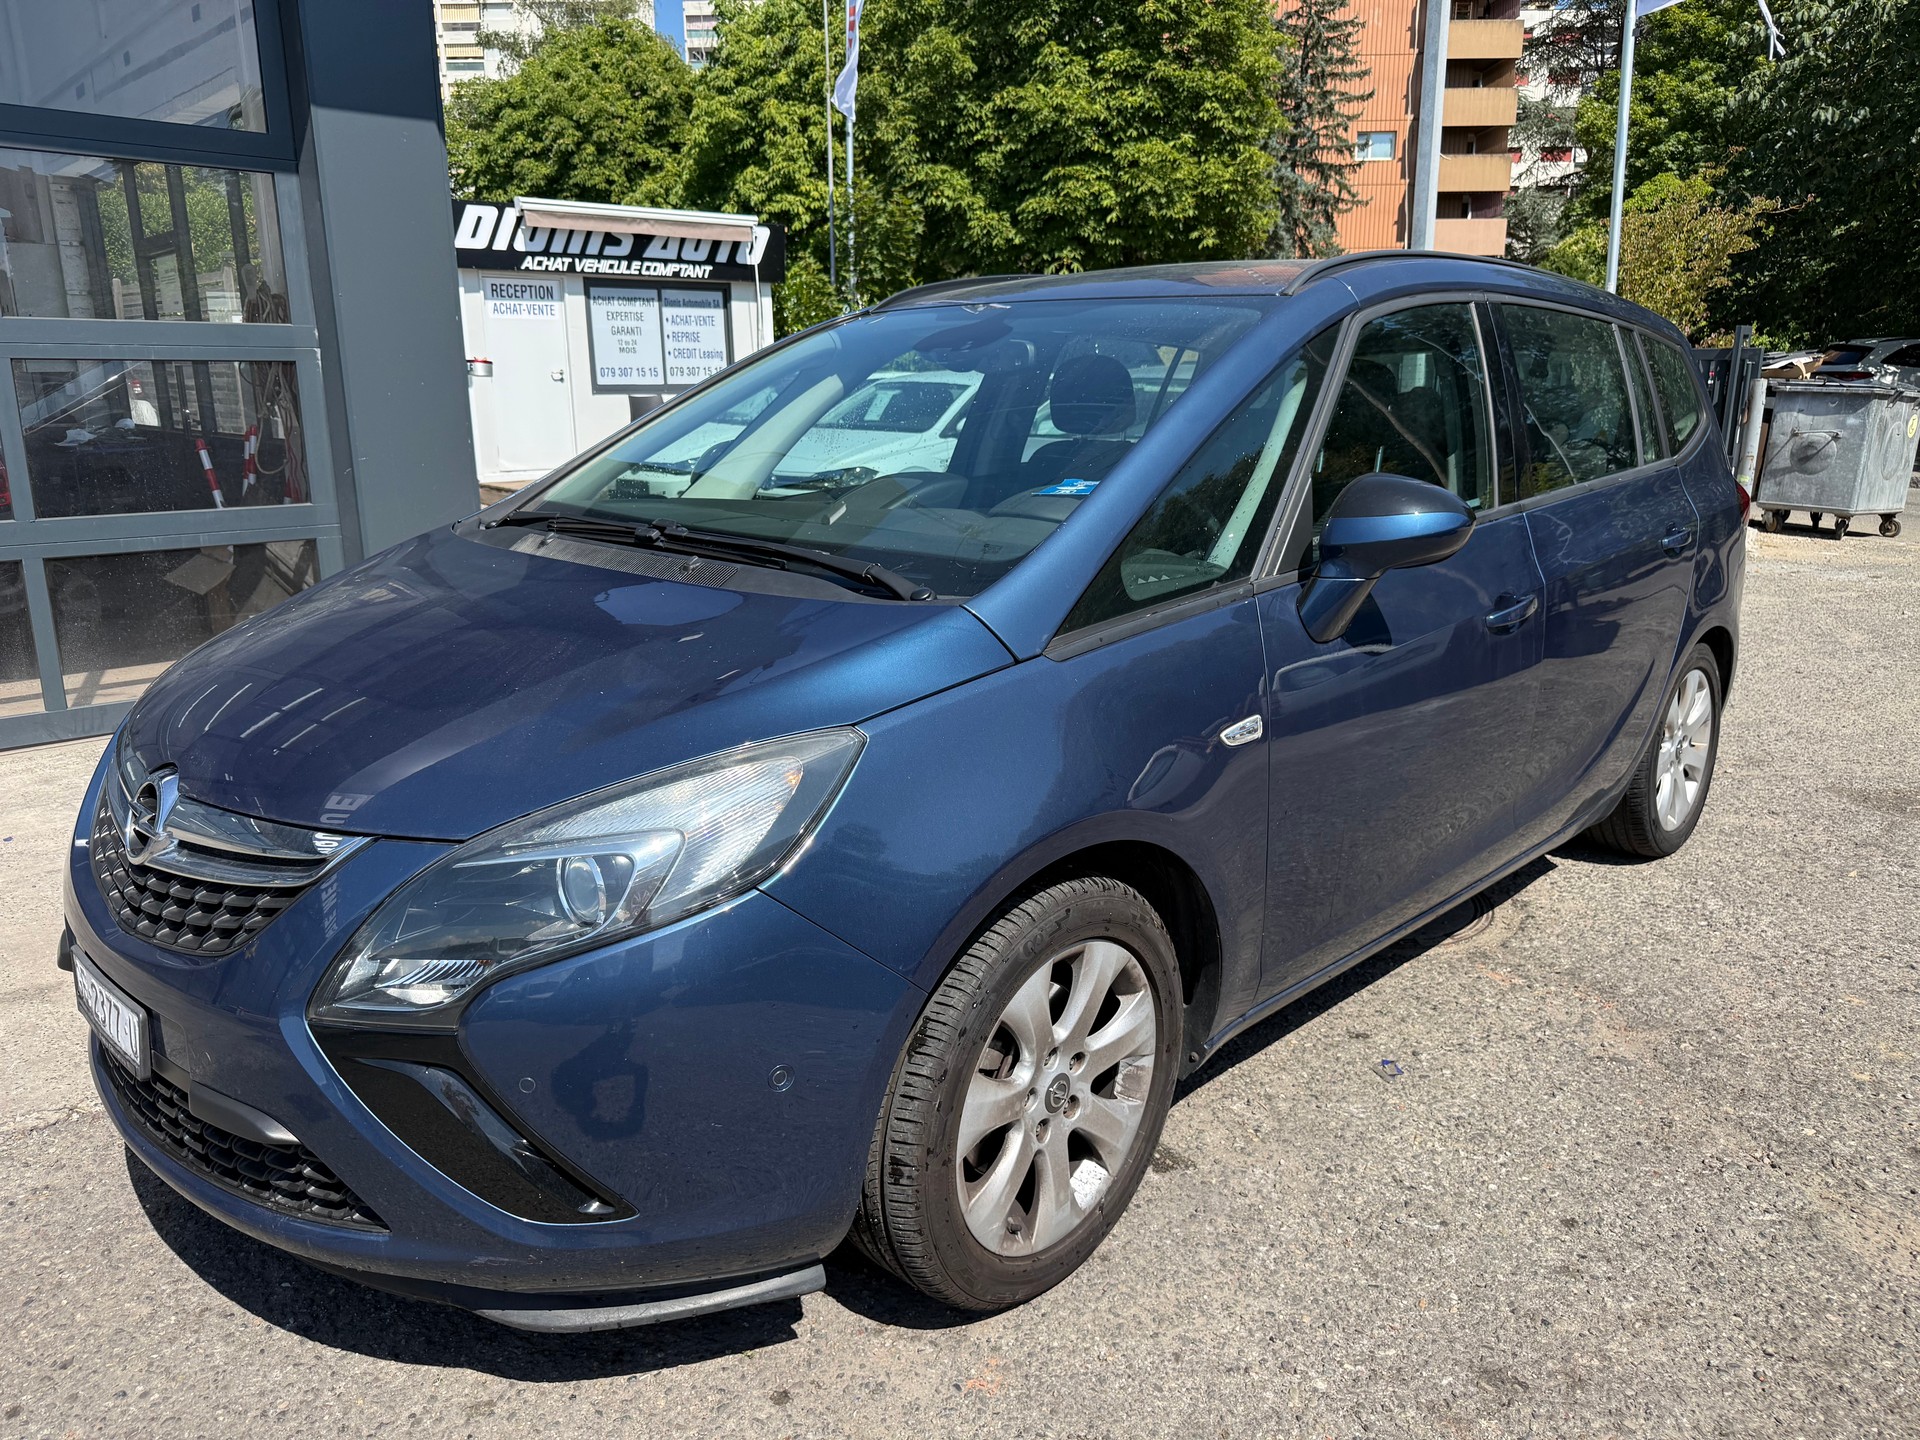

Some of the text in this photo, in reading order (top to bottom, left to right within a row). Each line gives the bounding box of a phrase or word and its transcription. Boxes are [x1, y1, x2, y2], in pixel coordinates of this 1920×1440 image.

[521, 255, 713, 279] ACHAT VEHICULE COMPTANT
[491, 283, 554, 300] RECEPTION
[592, 296, 655, 308] ACHAT COMPTANT
[493, 302, 556, 317] ACHAT-VENTE
[606, 311, 644, 322] EXPERTISE
[671, 314, 716, 327] ACHAT-VENTE
[611, 325, 642, 336] GARANTI
[672, 331, 701, 343] REPRISE
[619, 346, 637, 354] MOIS
[673, 348, 724, 362] CREDIT Leasing
[600, 367, 659, 378] 079 307 15 15
[670, 366, 685, 377] 079
[686, 366, 701, 377] 307
